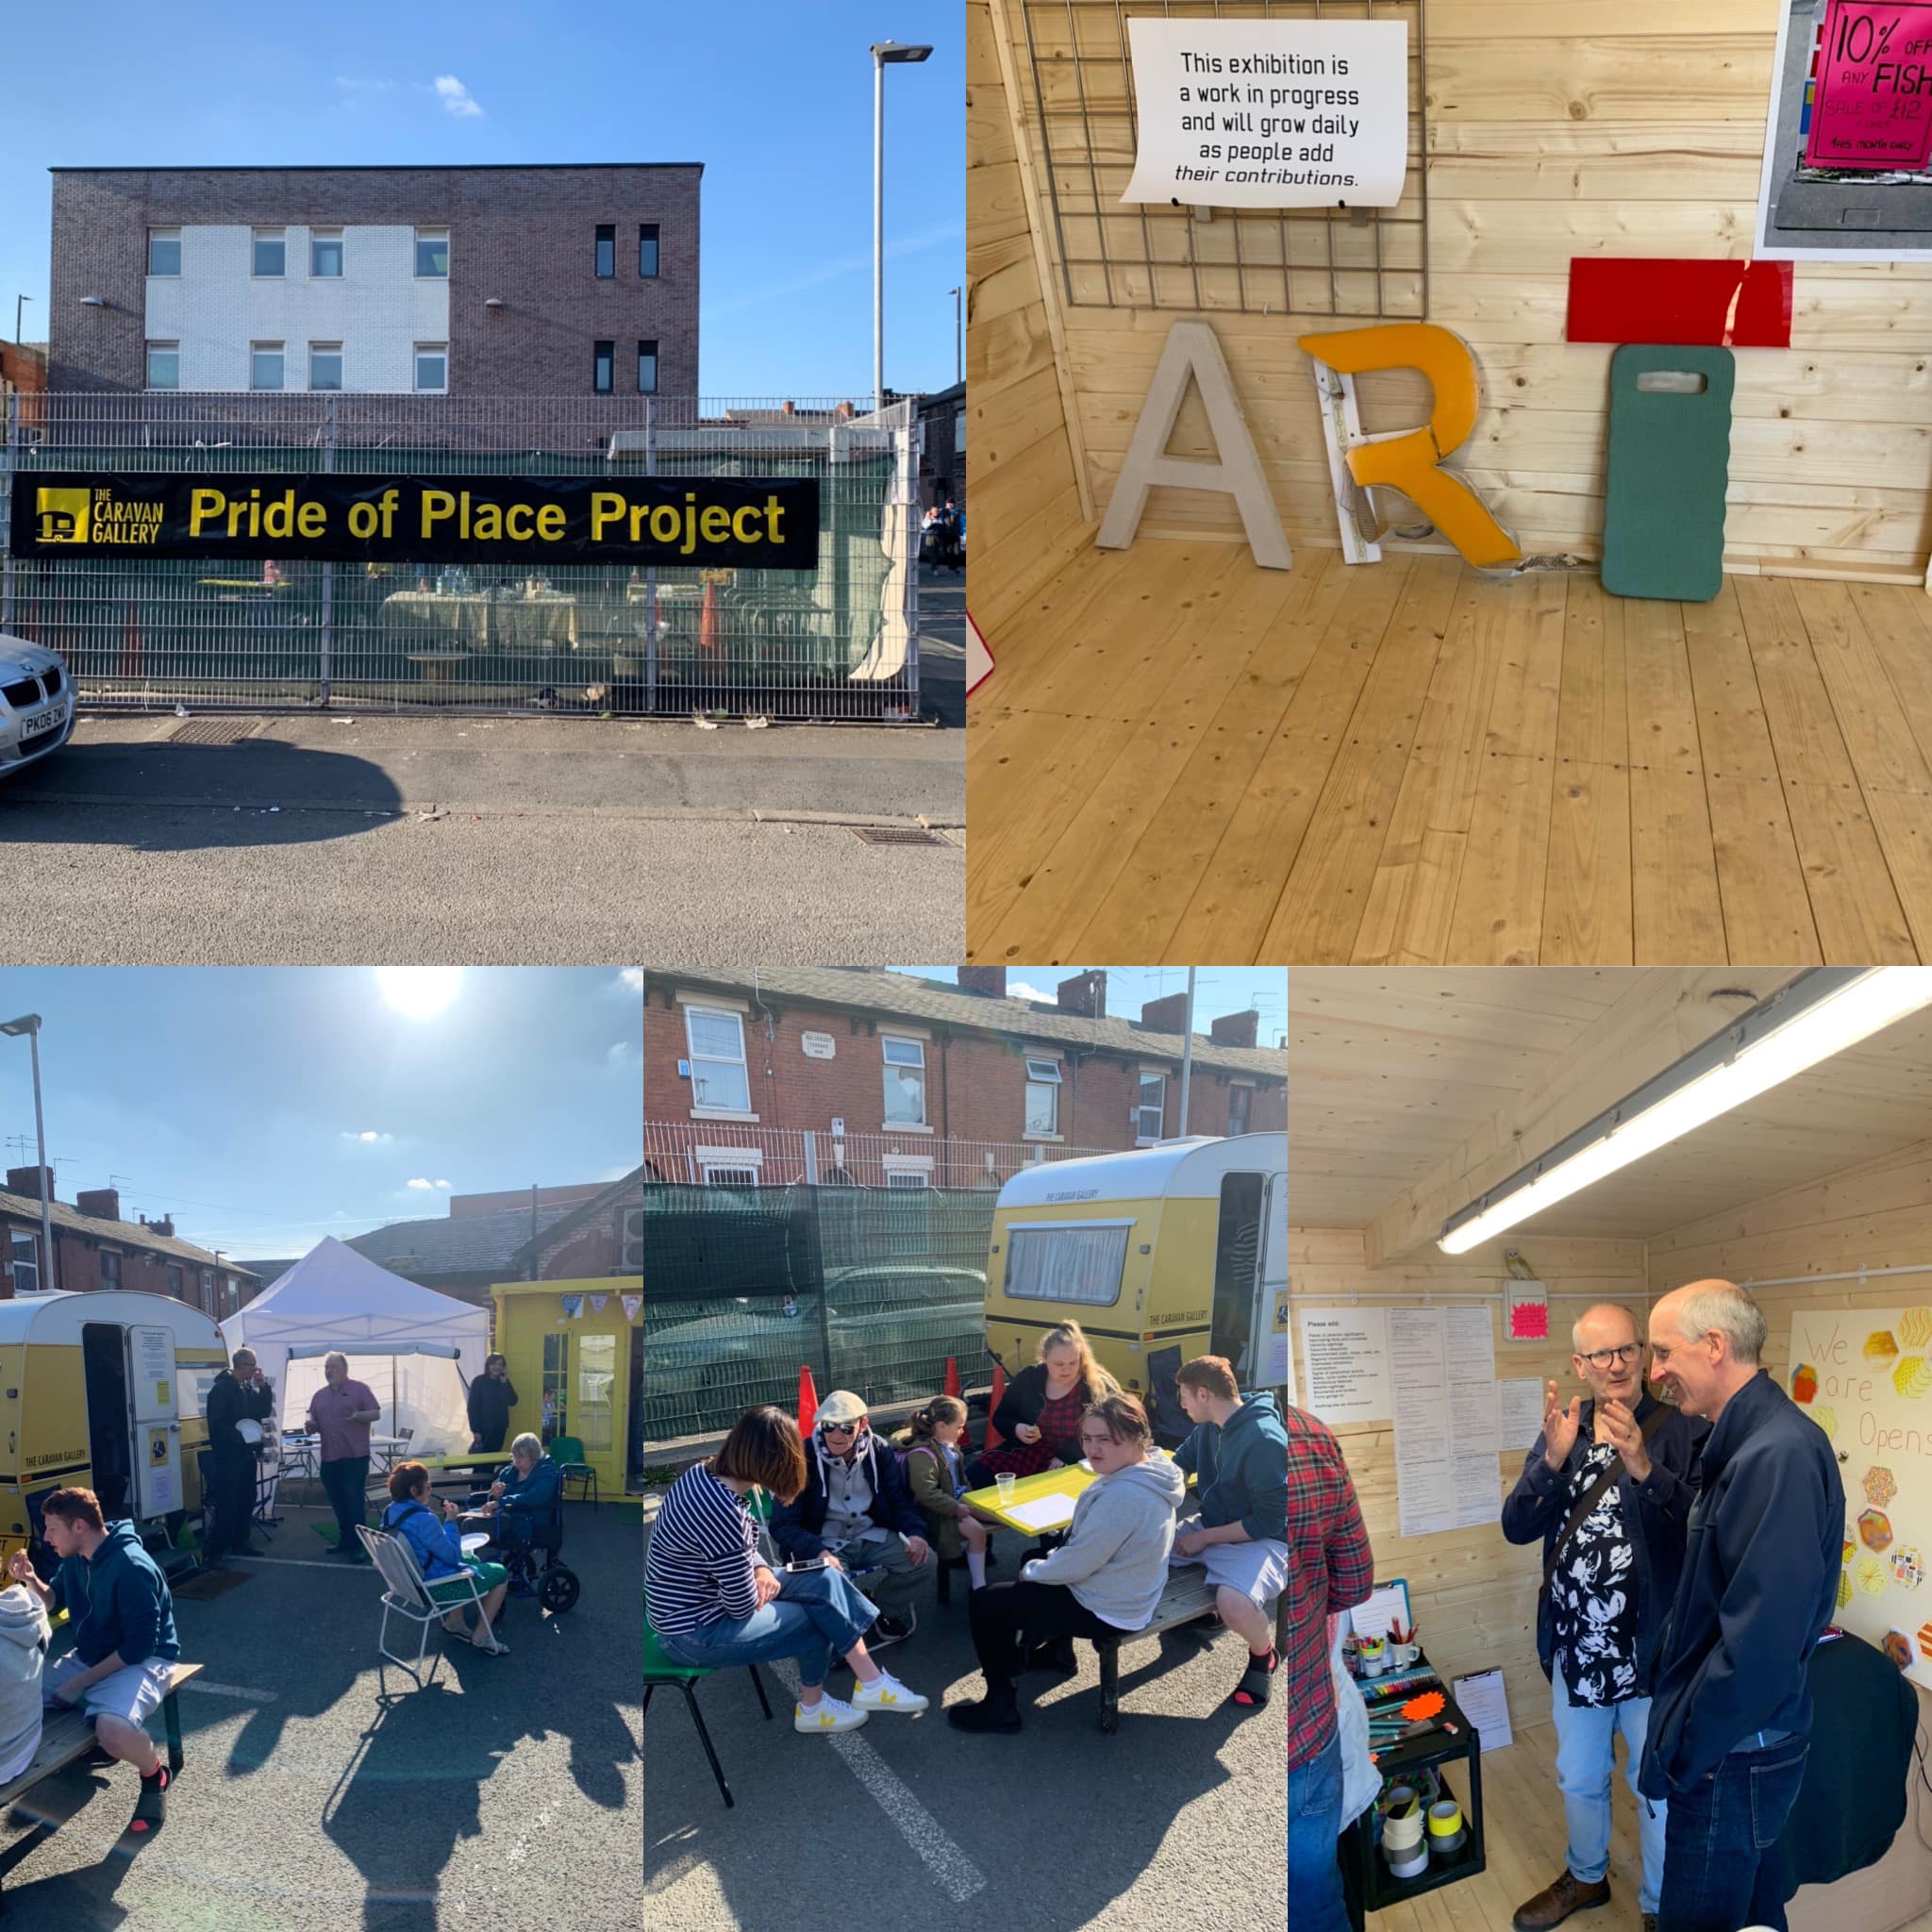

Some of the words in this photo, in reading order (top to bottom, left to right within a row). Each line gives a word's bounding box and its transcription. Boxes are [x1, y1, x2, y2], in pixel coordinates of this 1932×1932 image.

[1835, 14, 1901, 65] 10%
[1904, 39, 1932, 56] OFF
[1180, 52, 1223, 73] This
[1229, 54, 1325, 75] exhibition
[1331, 55, 1349, 75] is
[1841, 71, 1870, 84] ANY
[1871, 63, 1932, 95] FISH
[1179, 86, 1191, 102] a
[1197, 83, 1241, 103] work
[1246, 83, 1264, 104] in
[1270, 88, 1359, 109] progress
[1181, 111, 1215, 131] and
[1223, 112, 1254, 132] will
[1260, 117, 1307, 138] grow
[1311, 114, 1359, 138] daily
[1199, 144, 1222, 158] as
[1227, 142, 1292, 164] people
[1298, 143, 1334, 162] add
[1174, 165, 1220, 182] their
[1224, 168, 1359, 187] contributions.
[93, 488, 112, 501] THE
[93, 502, 164, 523] CARAVAN
[189, 488, 327, 539] Pride
[348, 489, 399, 539] of
[421, 490, 566, 541] Place
[591, 491, 786, 555] Project
[92, 522, 163, 544] GALLERY
[1804, 1324, 1849, 1366] We
[1825, 1374, 1874, 1402] are
[25, 1456, 37, 1467] THE
[64, 1449, 86, 1462] GALLERY
